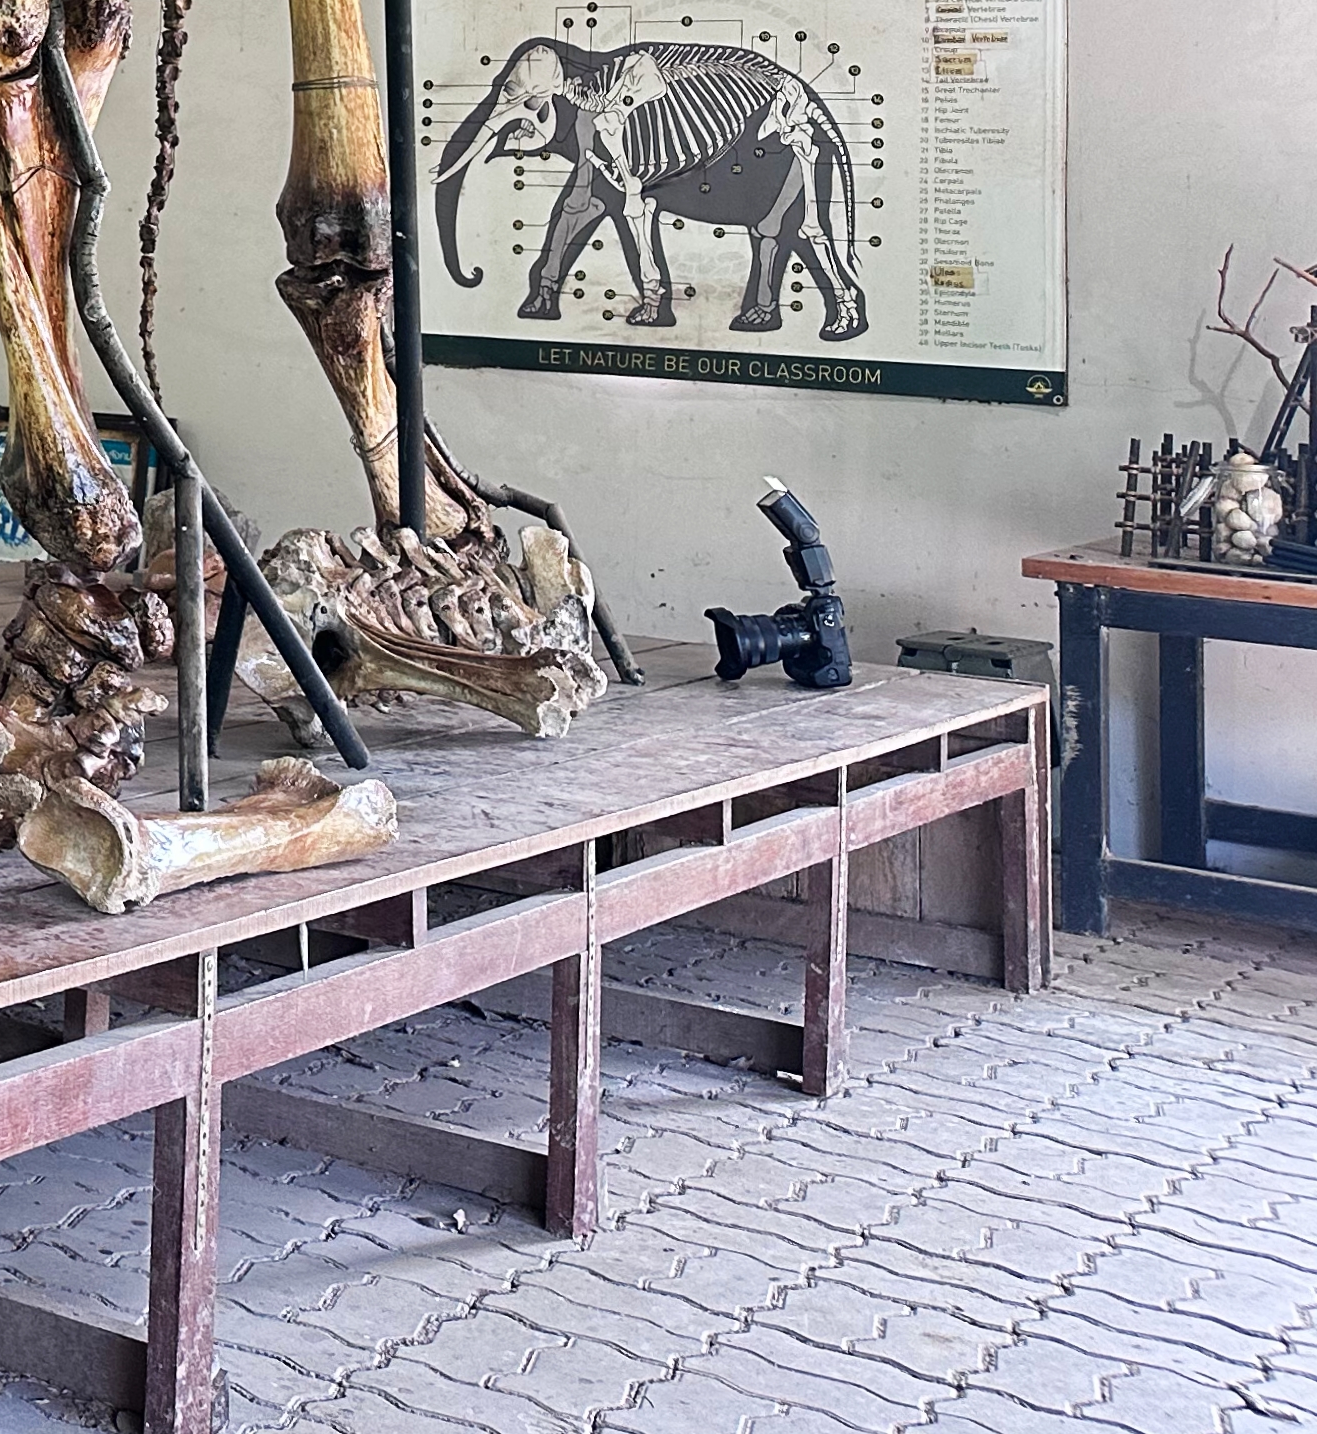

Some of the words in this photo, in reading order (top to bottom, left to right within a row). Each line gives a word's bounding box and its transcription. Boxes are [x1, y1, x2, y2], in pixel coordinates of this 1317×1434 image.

[949, 218, 968, 226] Cage
[539, 348, 572, 364] LET
[580, 350, 655, 370] NATURE
[665, 356, 689, 372] BE
[698, 358, 740, 376] OUR
[749, 361, 881, 384] CLASSROOM
